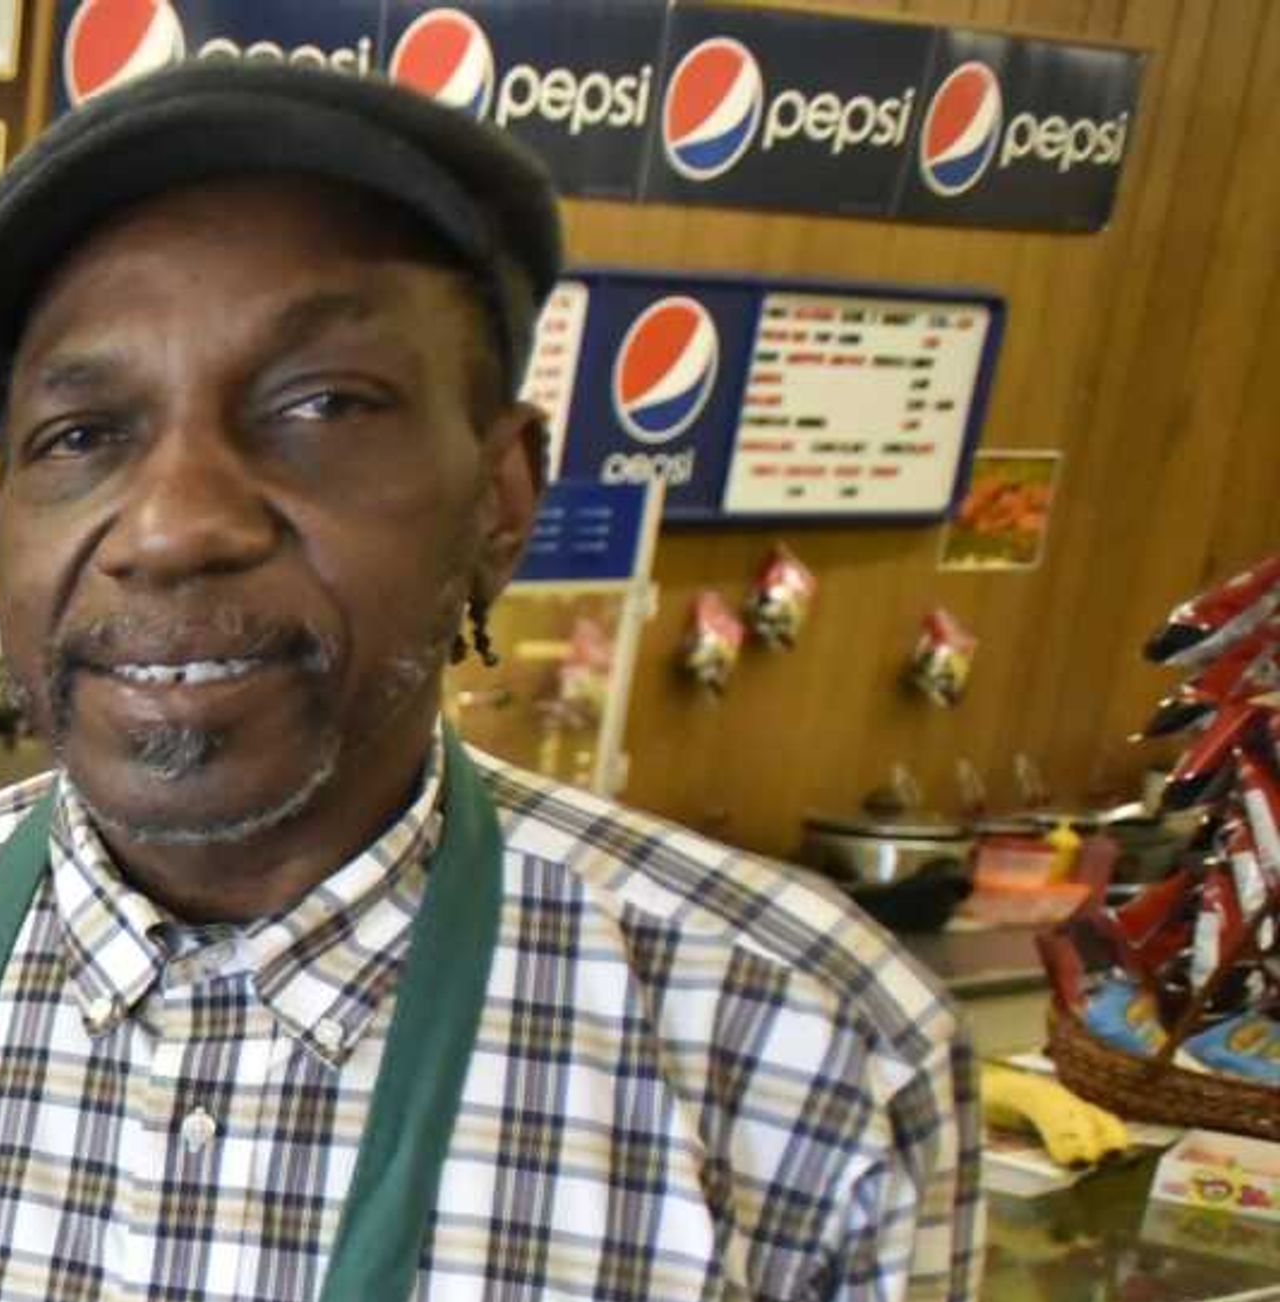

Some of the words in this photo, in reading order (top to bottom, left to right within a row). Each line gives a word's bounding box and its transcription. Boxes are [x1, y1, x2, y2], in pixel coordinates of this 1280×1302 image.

[495, 63, 654, 136] pepsi
[762, 86, 915, 155] pepsi
[1000, 111, 1128, 172] pepsi
